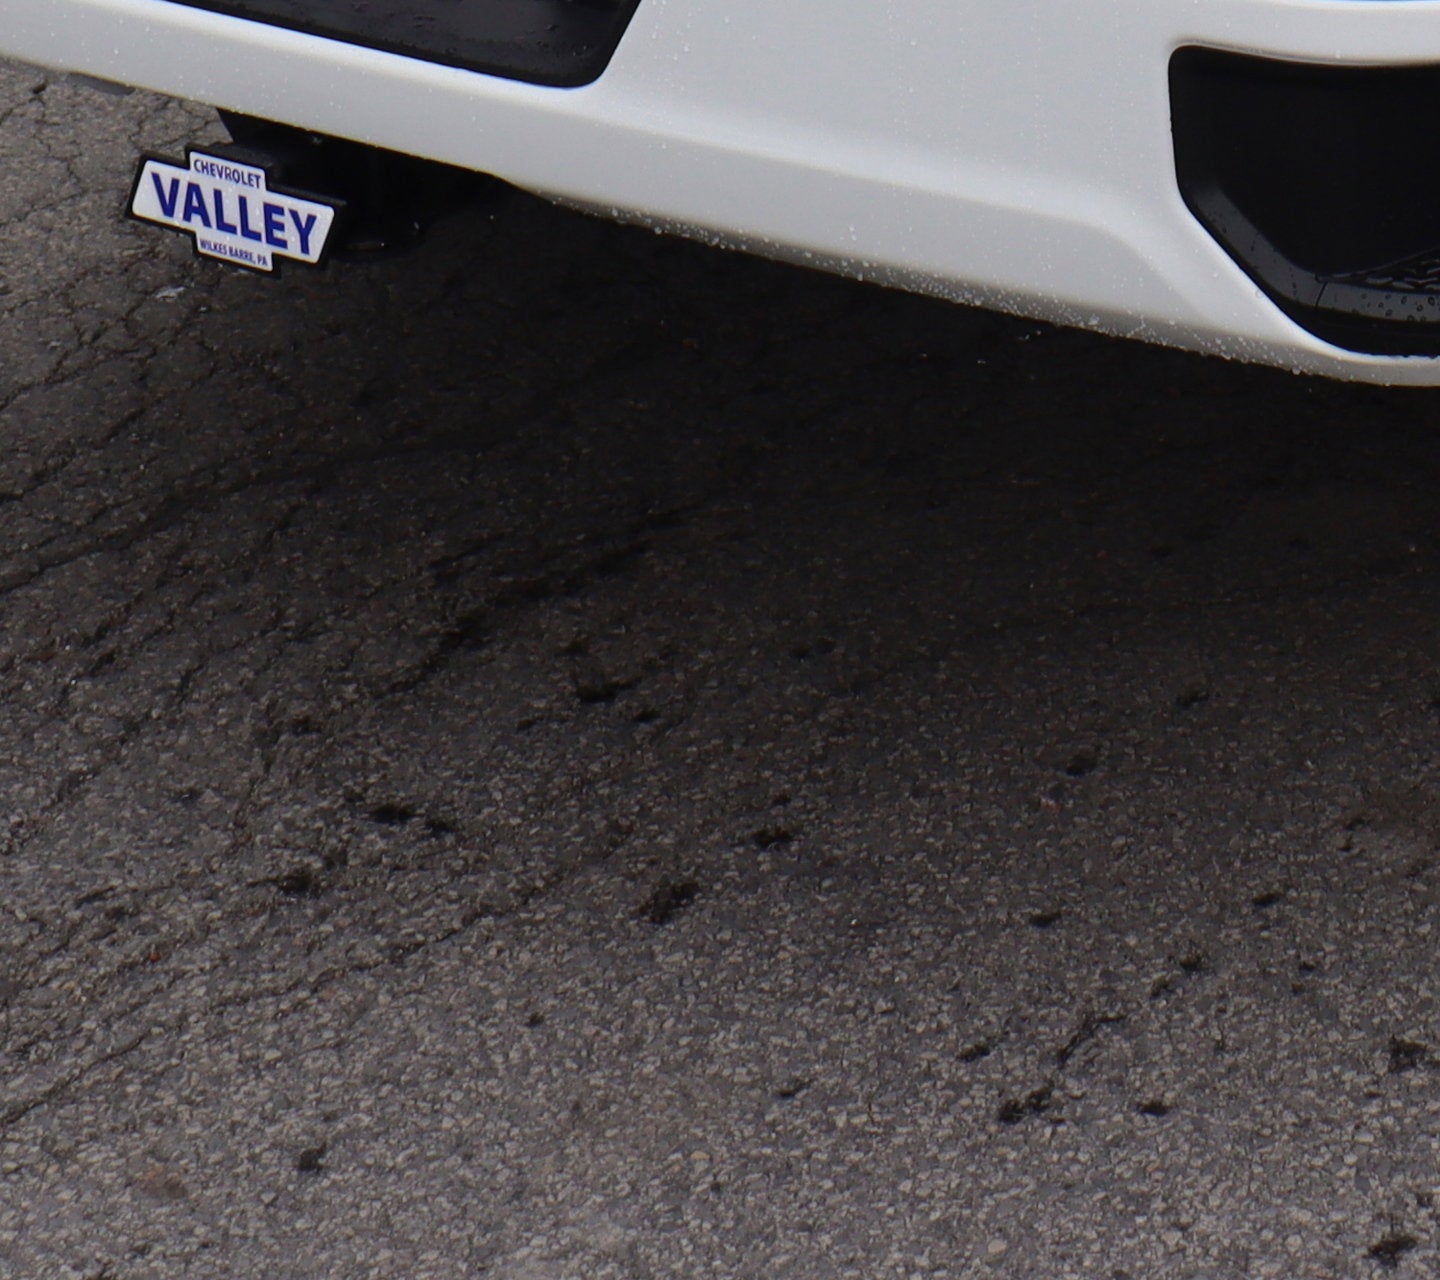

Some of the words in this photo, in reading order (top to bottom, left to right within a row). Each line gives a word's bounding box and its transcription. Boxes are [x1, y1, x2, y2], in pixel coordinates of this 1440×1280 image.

[193, 158, 262, 190] CHEVROLET
[151, 171, 318, 256] VALLEY
[199, 239, 228, 257] WILKES
[257, 253, 269, 268] PA
